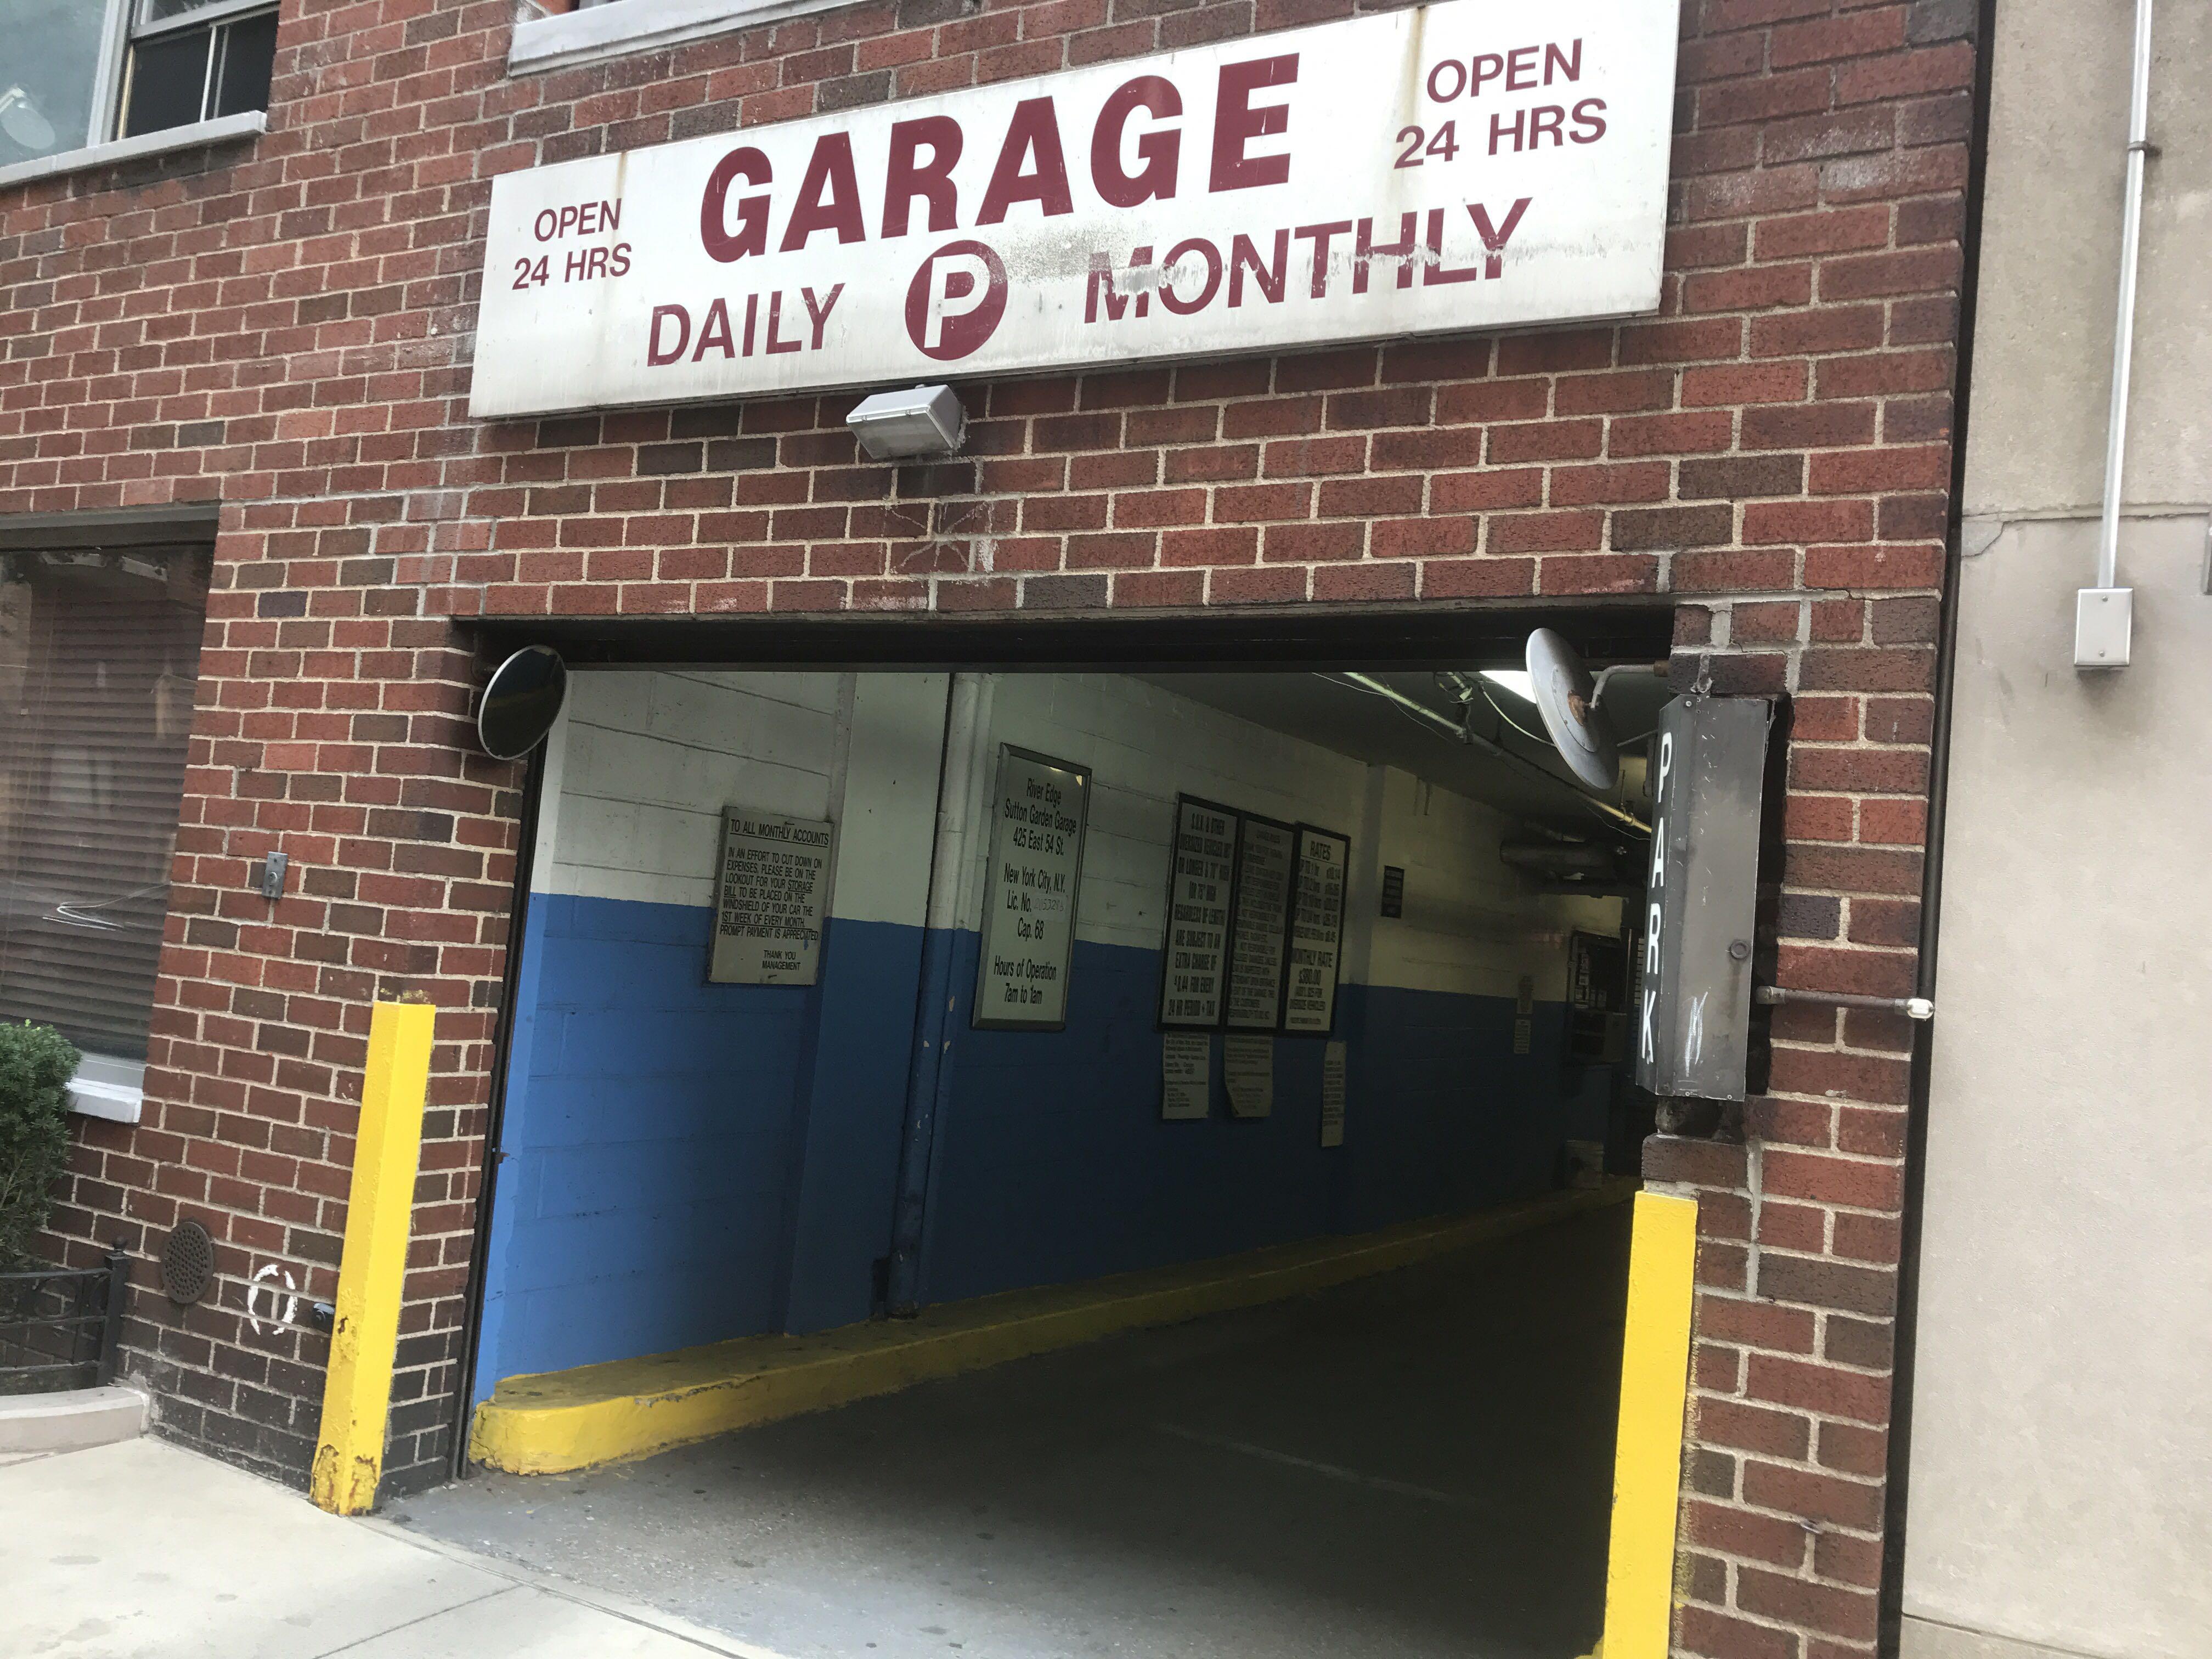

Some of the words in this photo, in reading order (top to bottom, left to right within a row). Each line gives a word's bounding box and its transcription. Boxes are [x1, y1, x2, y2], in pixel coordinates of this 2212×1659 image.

[1427, 38, 1582, 103] OPEN
[1394, 121, 1459, 168] 24
[1488, 98, 1607, 155] HRS
[701, 53, 1300, 263] GARAGE
[534, 198, 622, 242] OPEN
[512, 258, 550, 290] 24
[565, 242, 632, 283] HRS
[1085, 198, 1532, 323] MONTHLY
[647, 283, 845, 366] DAILY
[1026, 777, 1043, 799] River
[1046, 783, 1061, 805] Edge
[1005, 798, 1027, 822] Sutton
[1030, 804, 1053, 827] Garden
[1054, 814, 1076, 837] Garage
[731, 819, 741, 832] TO
[743, 822, 755, 835] ALL
[759, 824, 791, 839] MONTHLY
[793, 829, 829, 845] ACCOUNTS
[1013, 827, 1026, 848] 425
[1029, 831, 1042, 851] East
[1045, 835, 1054, 853] 54
[1056, 837, 1064, 856] St.
[729, 847, 734, 857] IN
[737, 848, 744, 859] AN
[747, 849, 769, 862] EFFORT
[772, 852, 780, 863] TO
[782, 854, 792, 865] CUT
[795, 856, 812, 868] DOWN
[814, 858, 822, 869] ON
[1310, 840, 1331, 861] RATES
[725, 872, 754, 885] LOOKOUT
[756, 876, 768, 887] FOR
[770, 877, 786, 888] YOUR
[788, 879, 812, 891] STORAGE
[761, 864, 783, 876] PLEASE
[785, 867, 792, 877] BE
[795, 867, 803, 878] ON
[806, 869, 816, 880] THE
[1004, 863, 1019, 883] New
[1022, 866, 1035, 888] York
[1037, 869, 1052, 894] City,
[1054, 873, 1065, 893] N.Y.
[724, 885, 736, 896] BILL
[740, 887, 747, 897] TO
[749, 887, 757, 898] BE
[760, 888, 782, 901] PLACED
[784, 891, 792, 902] ON
[795, 893, 805, 903] THE
[1007, 890, 1019, 911] Lic.
[1020, 893, 1031, 912] No.
[1641, 731, 1672, 1064] PARK
[721, 911, 732, 922] 1ST
[735, 912, 751, 923] WEEK
[754, 914, 762, 924] OF
[764, 915, 783, 925] EVERY
[723, 898, 759, 912] WINDSHIELD
[761, 901, 769, 912] OF
[772, 902, 787, 914] YOUR
[789, 904, 800, 915] CAR
[803, 906, 812, 916] THE
[719, 925, 745, 936] PROMPT
[747, 927, 772, 939] PAYMENT
[774, 928, 780, 938] IS
[1018, 917, 1031, 941] Cap.
[1035, 920, 1044, 939] 68
[762, 961, 800, 970] MANAGEMENT
[764, 950, 782, 960] THANK
[785, 950, 796, 960] YOU
[1317, 951, 1333, 968] RATE
[994, 955, 1014, 977] Hours
[1017, 957, 1024, 978] of
[1026, 961, 1057, 983] Operation
[1005, 983, 1018, 1003] 7am
[1020, 985, 1027, 1003] to
[1030, 985, 1042, 1005] 1am
